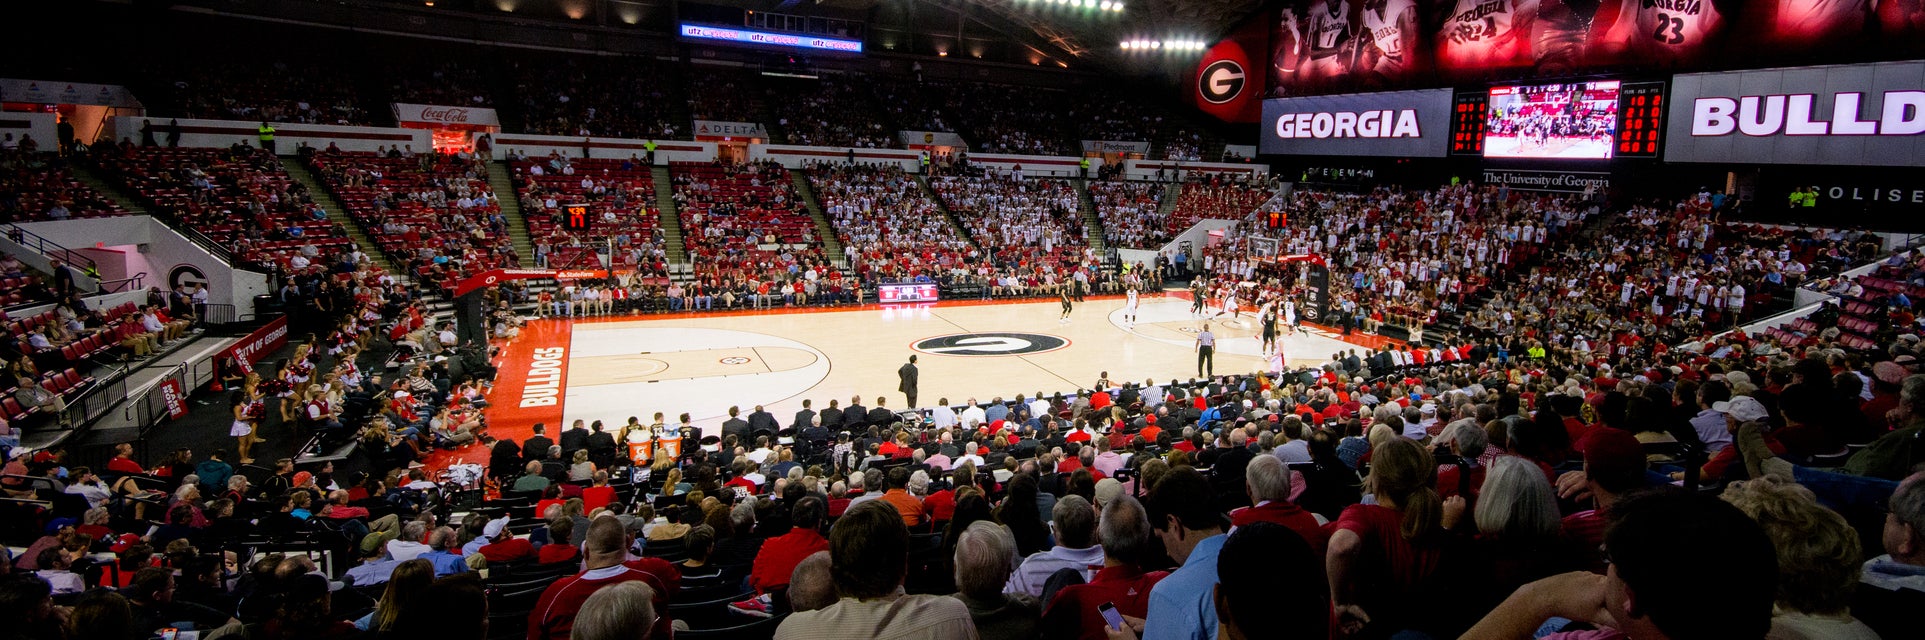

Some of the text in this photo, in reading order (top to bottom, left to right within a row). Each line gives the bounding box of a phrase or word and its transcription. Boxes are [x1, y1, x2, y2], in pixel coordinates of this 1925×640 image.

[1456, 0, 1507, 22] GEORGIA
[688, 27, 702, 35] utz
[1654, 13, 1685, 44] 23
[751, 33, 764, 41] utz
[1327, 33, 1333, 46] 1
[812, 39, 825, 47] utz
[1199, 60, 1245, 104] G
[1586, 82, 1595, 90] 16
[1638, 96, 1645, 106] 0
[1653, 95, 1661, 106] 2
[1626, 107, 1635, 118] 2
[1651, 107, 1659, 117] 0
[1691, 91, 1925, 136] BULLD
[1276, 108, 1422, 139] GEORGIA
[1635, 119, 1643, 129] 0
[1652, 119, 1659, 129] 7
[713, 125, 757, 135] DELTA
[1648, 130, 1657, 141] 0
[1632, 142, 1640, 152] 0
[1647, 142, 1655, 152] 0
[1483, 172, 1610, 189] The University of Georgia
[255, 338, 264, 350] OF
[264, 324, 288, 345] GEORGIA
[519, 346, 565, 408] BULLDOGS
